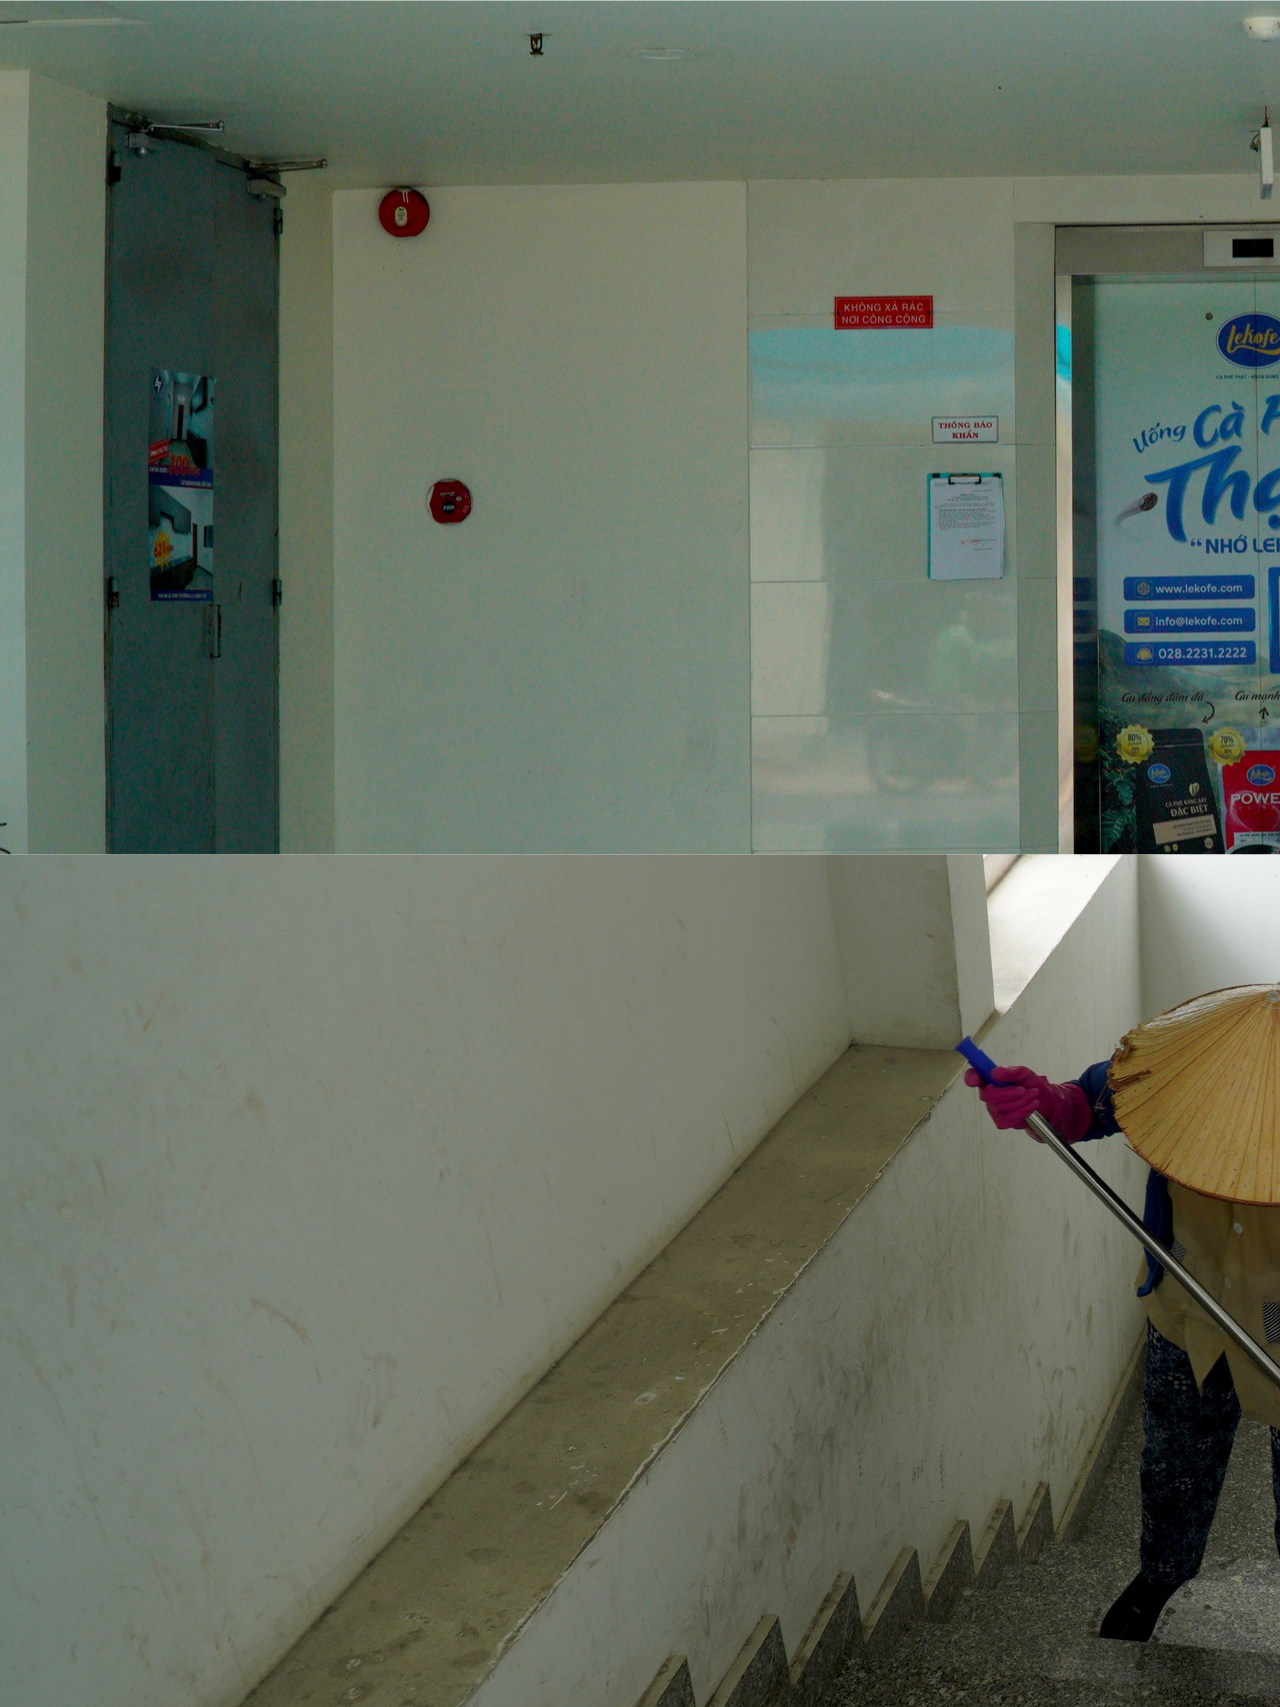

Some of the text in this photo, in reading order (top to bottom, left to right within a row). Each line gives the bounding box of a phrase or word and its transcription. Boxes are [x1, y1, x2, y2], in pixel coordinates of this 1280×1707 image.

[844, 300, 924, 312] KHÔNG XẢ RÁC
[841, 313, 926, 325] NƠI CÔNG CỘNG
[938, 420, 993, 429] THÔNG BÁO
[1132, 422, 1187, 453] Uống
[1193, 400, 1246, 449] Cà
[1155, 583, 1243, 594] www.lekofe.com
[1155, 616, 1243, 627] info@lekofe.com
[1158, 647, 1247, 659] 028.2231.2222
[1121, 692, 1135, 703] Gu
[1138, 691, 1163, 705] đắng
[1165, 691, 1188, 704] đậm
[1234, 690, 1249, 701] Gu
[1250, 690, 1280, 703] mạnh
[1127, 733, 1142, 742] 80%
[1220, 735, 1234, 744] 70%
